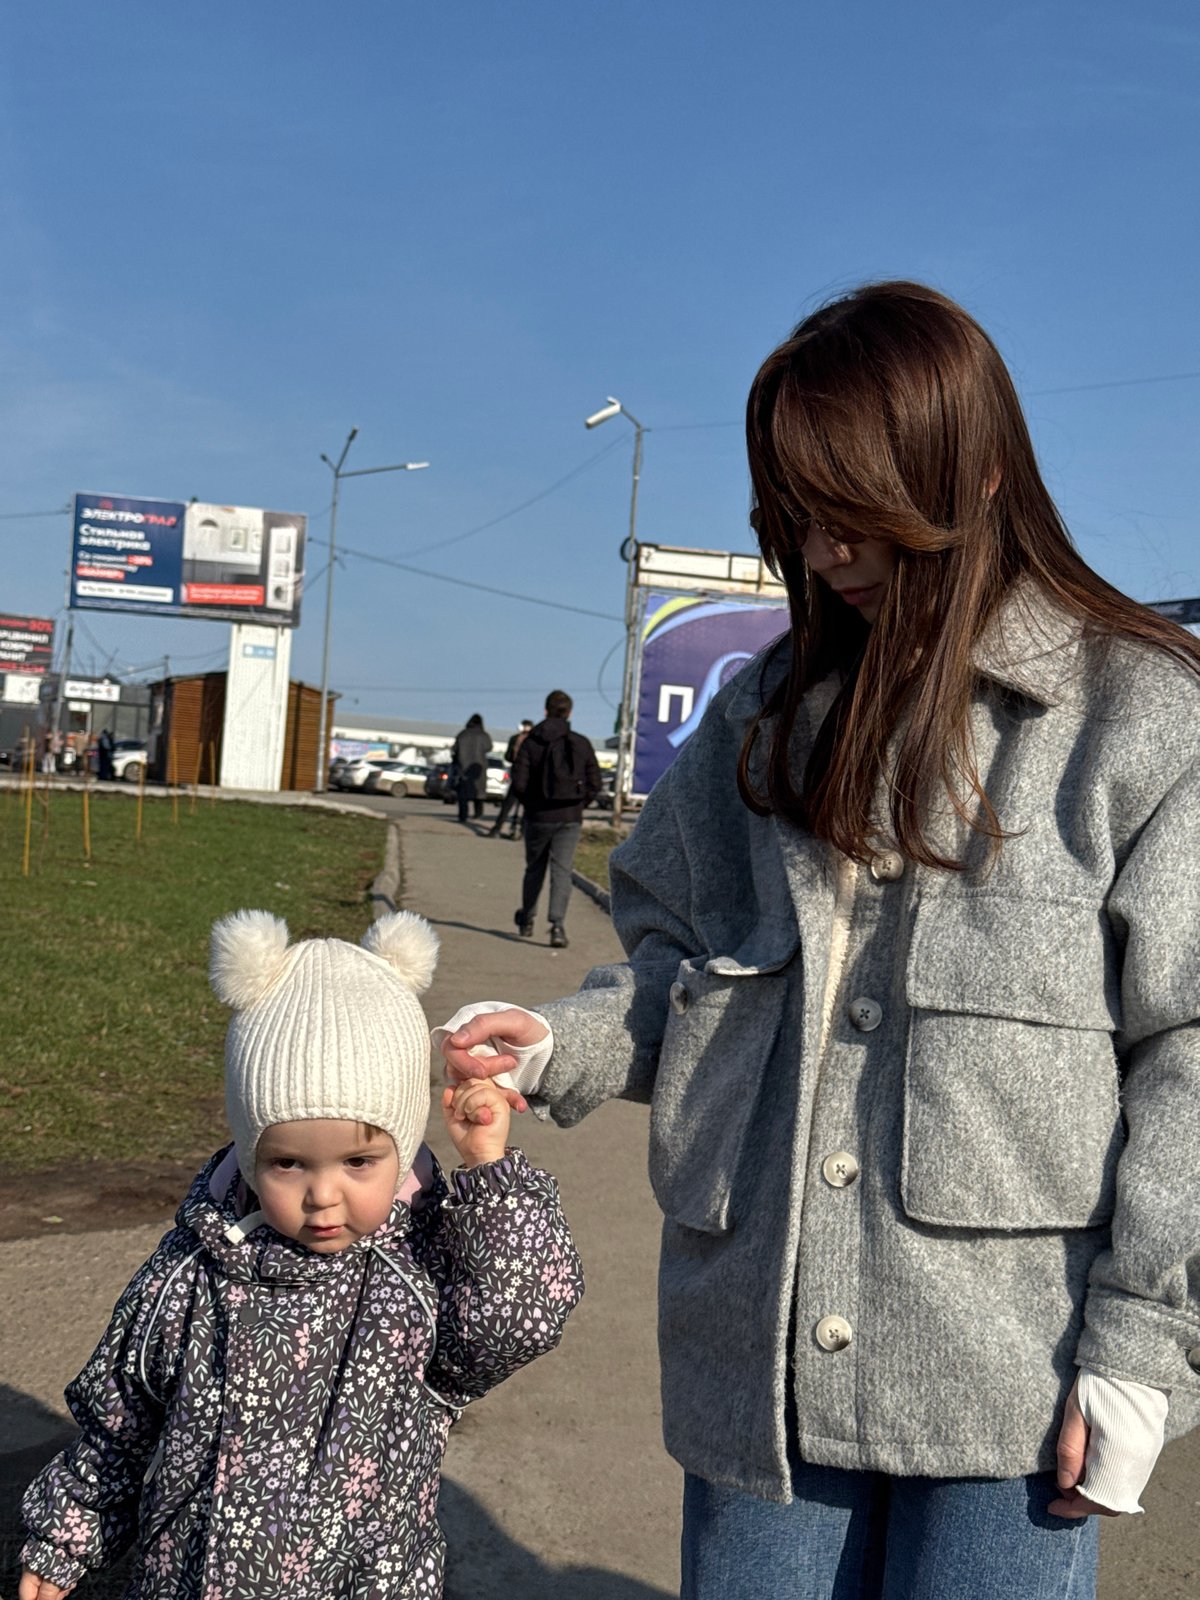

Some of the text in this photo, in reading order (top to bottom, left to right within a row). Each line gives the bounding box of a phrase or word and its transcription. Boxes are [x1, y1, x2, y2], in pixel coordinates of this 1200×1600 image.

[81, 508, 176, 526] ЭЛЕКТРОГРАД
[79, 523, 145, 541] Стильная
[79, 536, 151, 552] электрика
